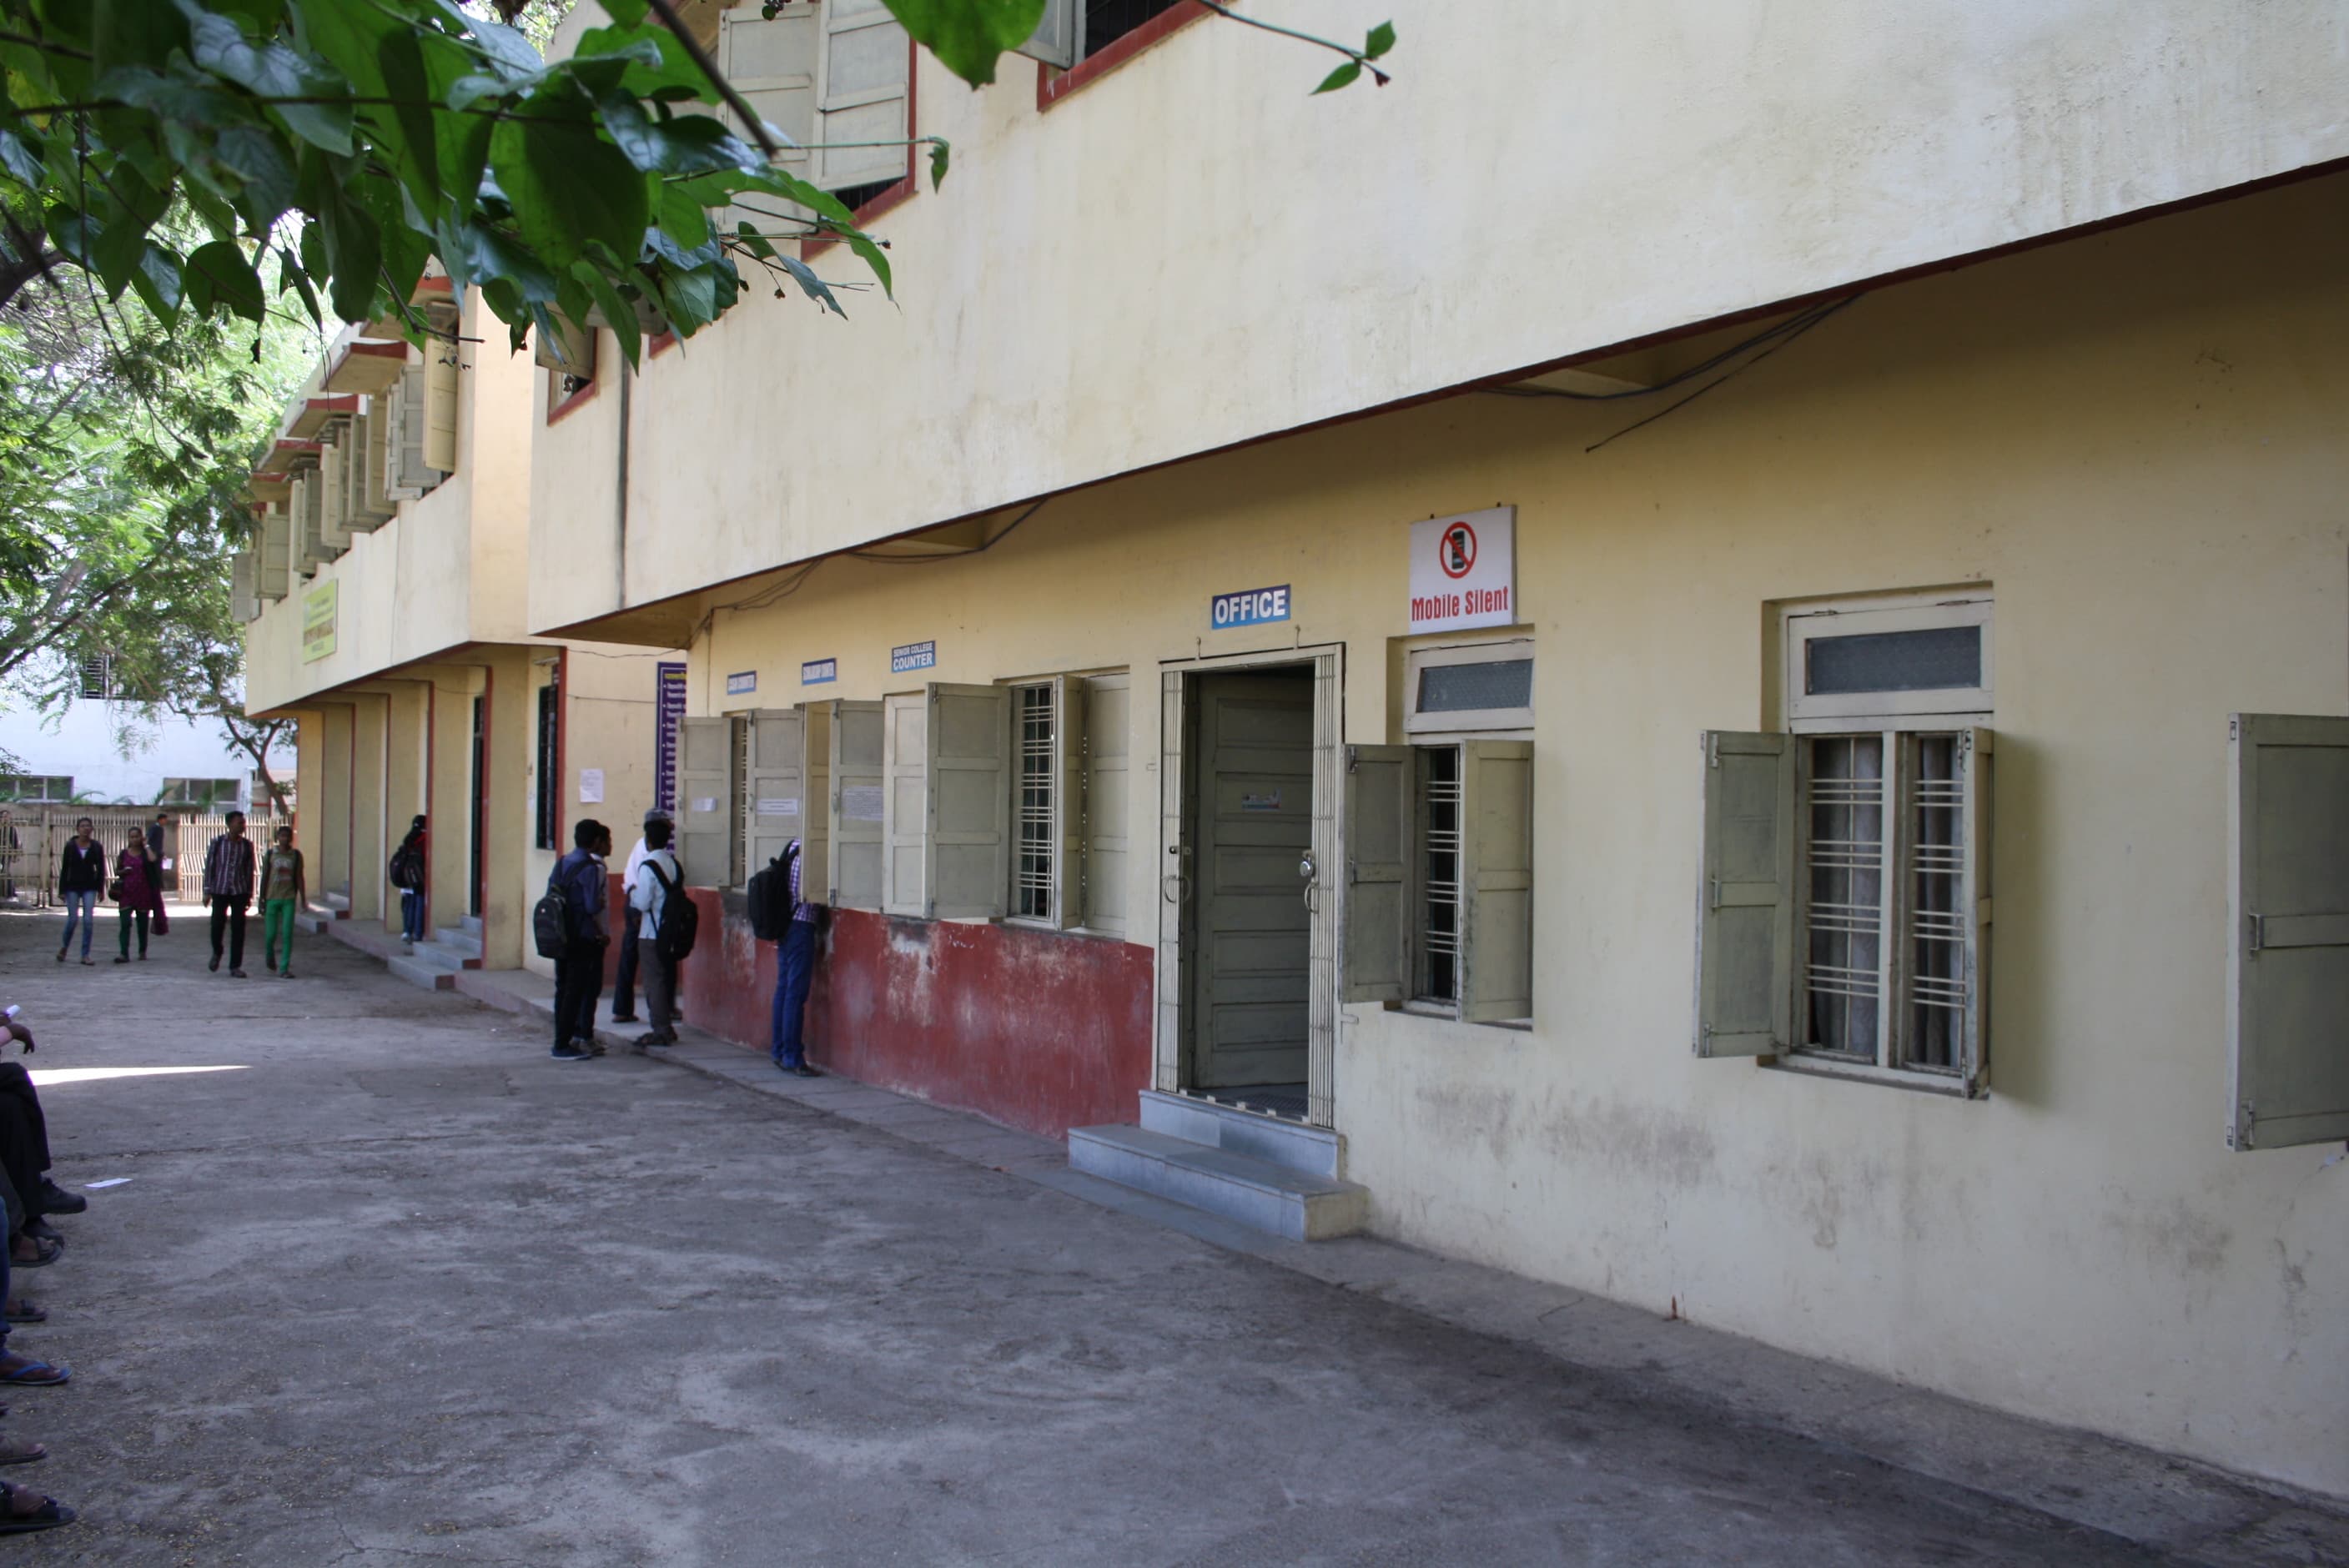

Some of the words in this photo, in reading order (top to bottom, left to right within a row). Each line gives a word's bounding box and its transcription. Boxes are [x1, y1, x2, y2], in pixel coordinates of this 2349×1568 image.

[1215, 589, 1285, 625] OFFICE
[1411, 594, 1460, 621] Mobile
[1465, 585, 1508, 615] Silent
[893, 652, 933, 671] COUNTER
[910, 642, 933, 655] COLLEGE
